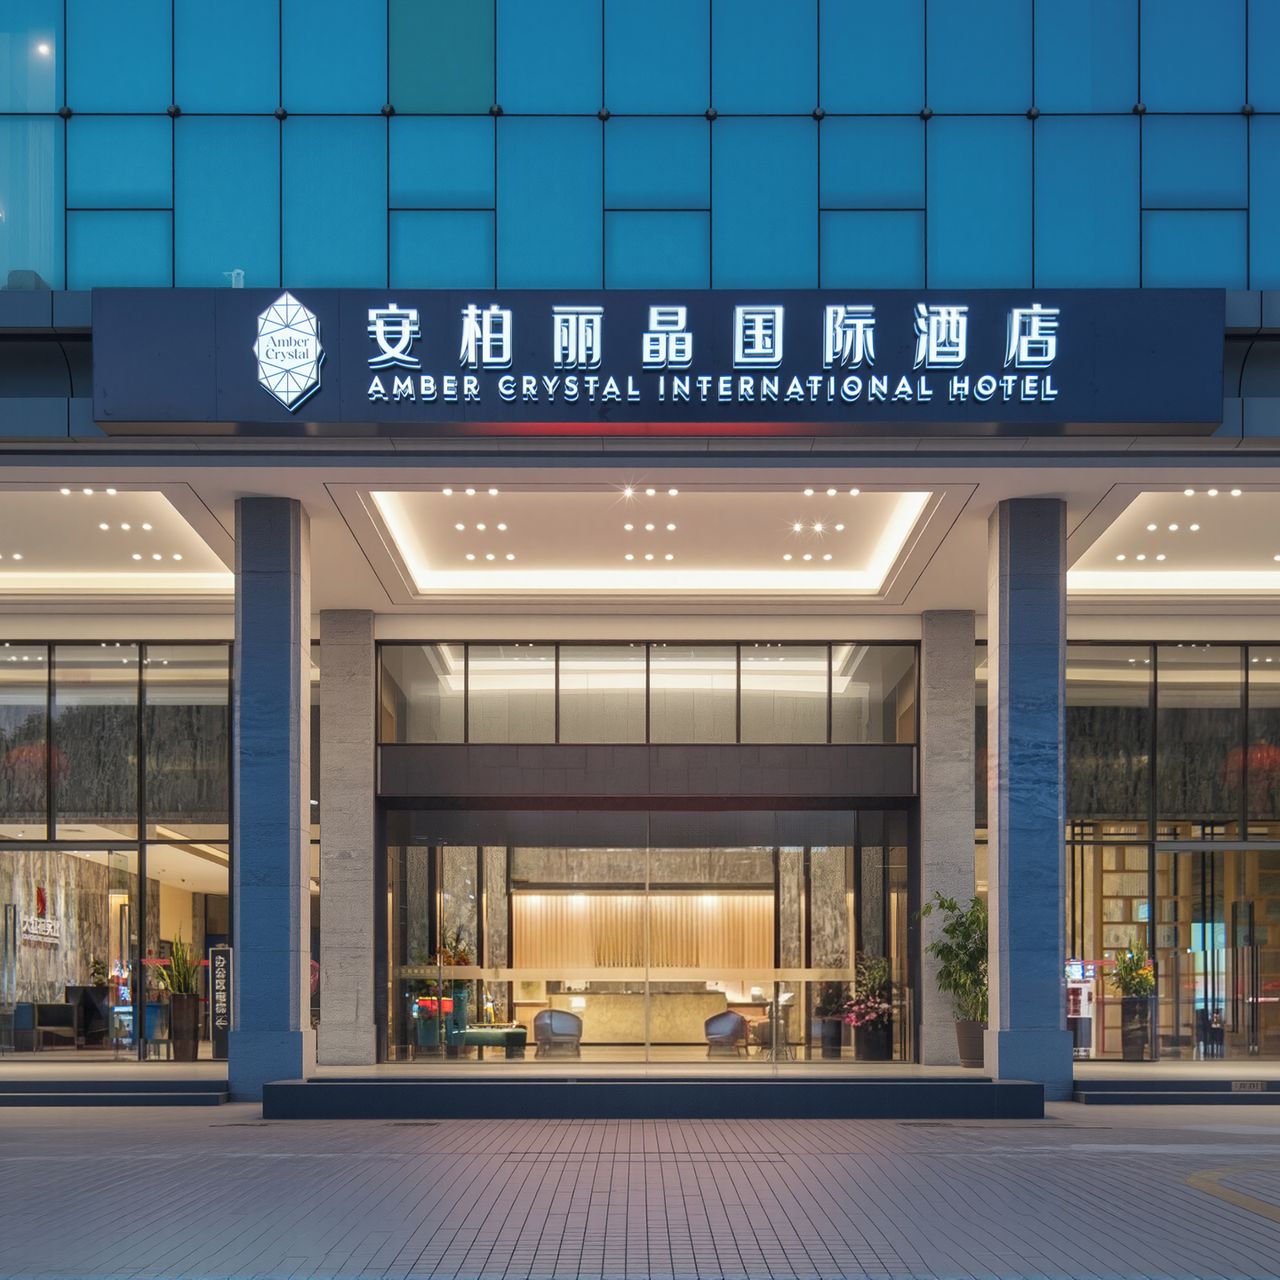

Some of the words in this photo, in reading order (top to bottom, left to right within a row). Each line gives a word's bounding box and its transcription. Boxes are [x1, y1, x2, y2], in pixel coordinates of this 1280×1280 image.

[266, 335, 310, 348] Amber
[367, 303, 1061, 369] 安柏丽晶国际酒店
[265, 348, 310, 362] Crystal
[367, 375, 481, 401] AMBER
[498, 375, 640, 401] CRYSTAL
[658, 375, 933, 401] INTERNATIONAL
[950, 375, 1059, 401] HOTEL
